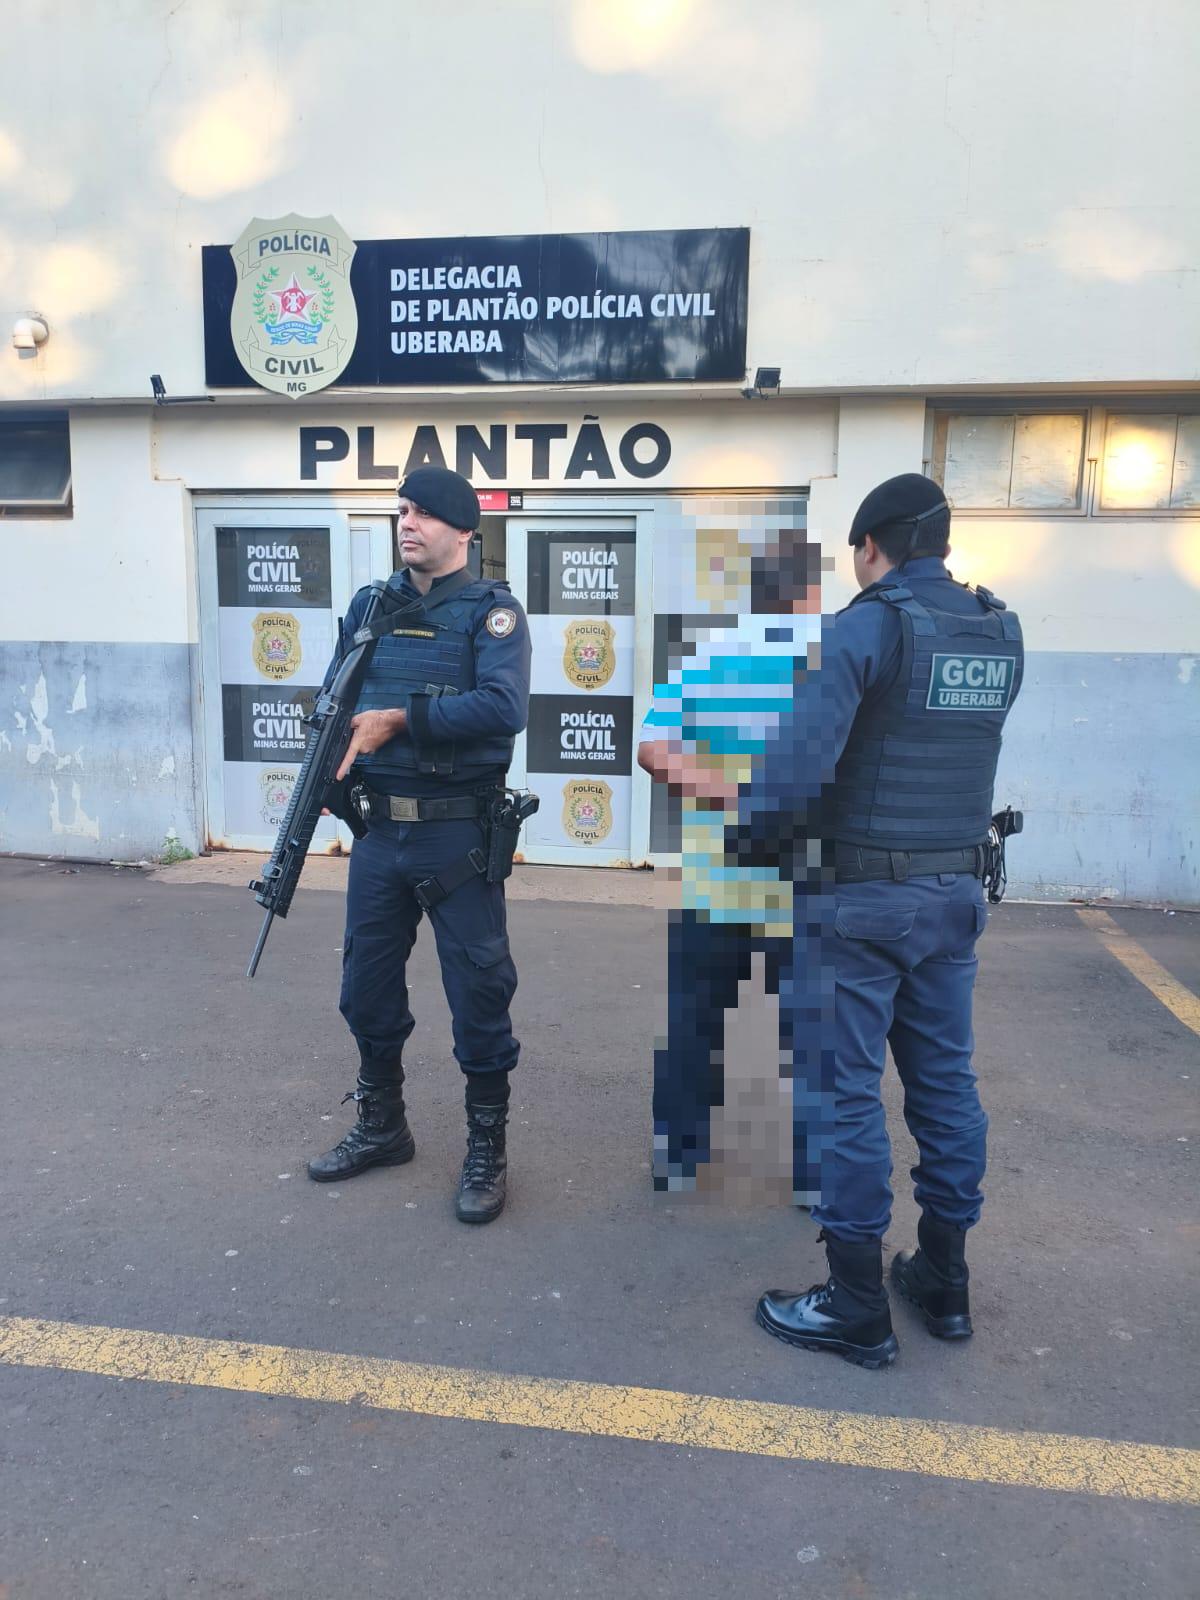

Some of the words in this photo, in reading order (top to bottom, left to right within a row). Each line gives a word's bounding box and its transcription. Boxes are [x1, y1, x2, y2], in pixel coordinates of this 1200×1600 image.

[259, 230, 331, 256] POLÍCIA
[390, 265, 522, 291] DELEGACIA
[390, 300, 421, 323] DE
[427, 291, 538, 322] PLANTÃO
[546, 289, 644, 320] POLÍCIA
[650, 293, 716, 318] CIVIL
[390, 330, 504, 354] UBERABA
[264, 357, 324, 375] CIVIL
[287, 382, 307, 392] MG
[299, 414, 672, 480] PLANTÃO
[247, 542, 300, 560] POLÍCIA
[562, 547, 619, 566] POLÍCIA
[247, 561, 302, 583] CIVIL
[561, 567, 619, 589] CIVIL
[248, 584, 273, 593] MINAS
[274, 584, 302, 593] GERAIS
[562, 591, 589, 600] MINAS
[590, 591, 619, 600] GERAIS
[262, 617, 292, 628] POLÍCIA
[575, 625, 606, 635] POLÍCIA
[265, 664, 289, 673] CIVIL
[942, 658, 1007, 687] GCM
[576, 674, 601, 682] CIVIL
[939, 692, 1002, 706] UBERABA
[252, 700, 304, 717] POLÍCIA
[560, 710, 616, 728] POLÍCIA
[253, 718, 306, 740] CIVIL
[253, 740, 279, 749] MINAS
[279, 740, 306, 749] GERAIS
[560, 729, 616, 750] CIVIL
[560, 751, 587, 760] MINAS
[587, 752, 616, 761] GERAIS
[267, 772, 295, 782] POLÍCIA
[573, 784, 603, 795] POLÍCIA
[574, 831, 600, 839] CIVIL
